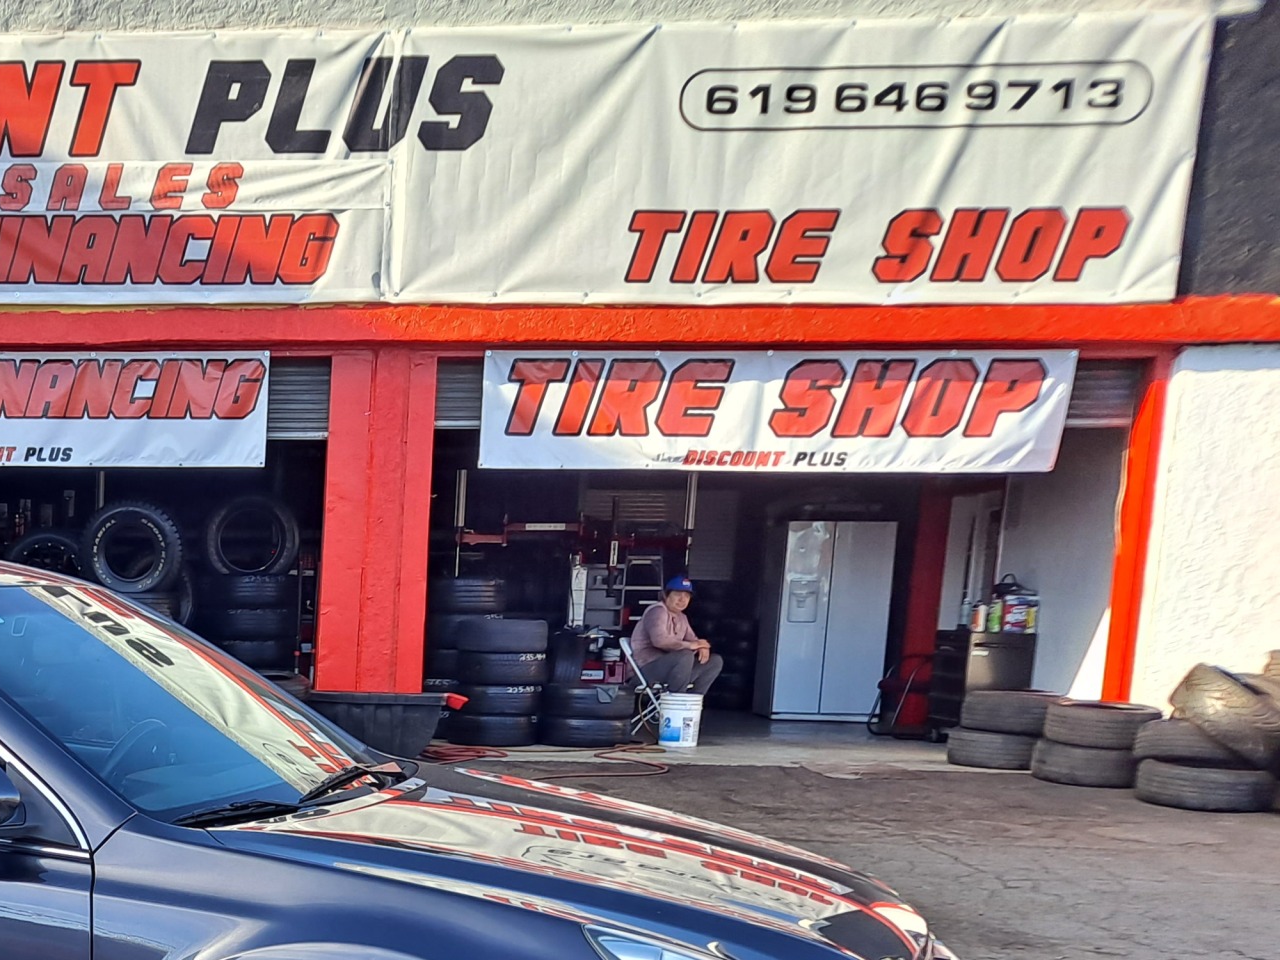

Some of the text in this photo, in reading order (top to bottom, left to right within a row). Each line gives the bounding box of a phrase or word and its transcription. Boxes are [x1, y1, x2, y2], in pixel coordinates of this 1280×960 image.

[184, 53, 506, 154] PLUS
[705, 78, 1126, 114] 619 646 9713
[624, 207, 1131, 283] TIRE SHOP
[504, 357, 1049, 438] TIRE SHOP
[24, 447, 73, 462] PLUS
[682, 450, 848, 467] DISCOUNT PLUS
